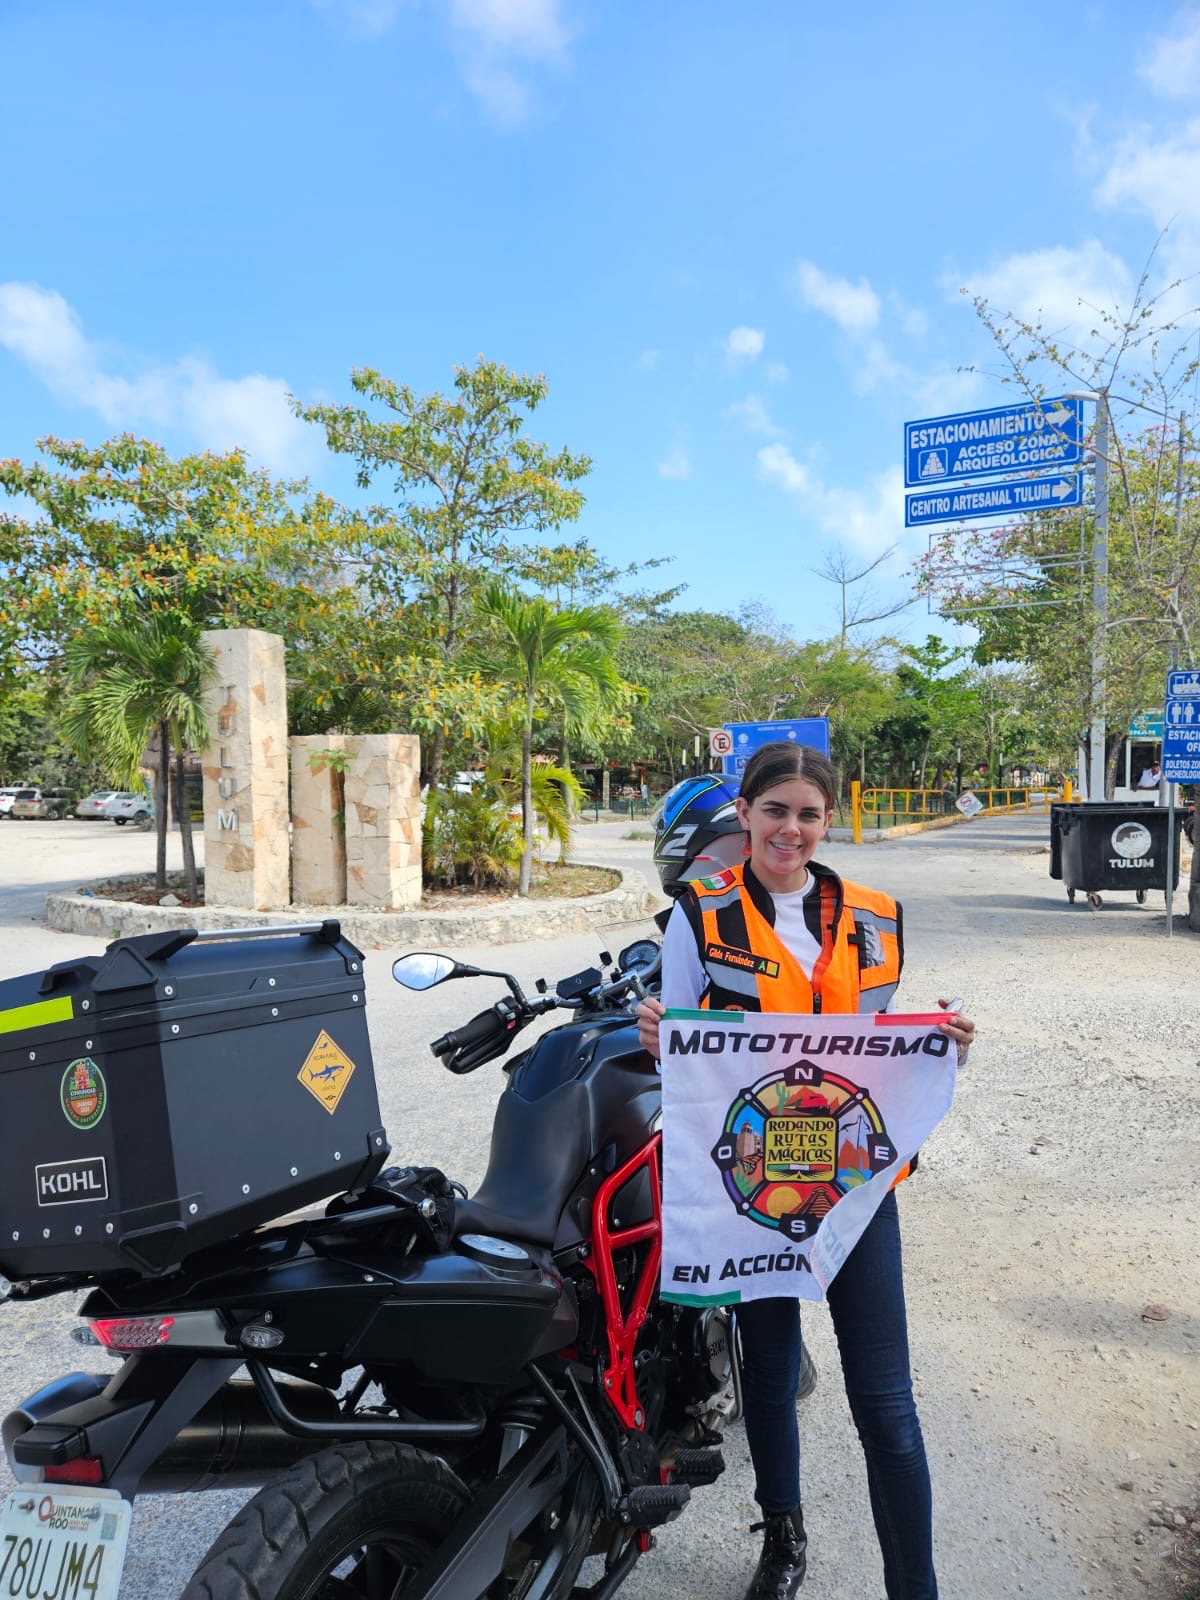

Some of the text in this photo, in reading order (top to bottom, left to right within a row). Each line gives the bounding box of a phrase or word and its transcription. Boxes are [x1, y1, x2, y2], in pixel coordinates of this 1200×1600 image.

[910, 412, 1044, 449] ESTACIONAMIENTO
[958, 432, 1059, 459] ACCESO ZONA
[953, 446, 1066, 473] ARQUEOLOGICA
[911, 484, 1051, 517] CENTRO ARTESANAL TULUM
[1168, 730, 1200, 741] ESTACI
[217, 684, 238, 831] TULUM
[1165, 759, 1190, 769] BOLETOS
[1108, 858, 1154, 869] TULUM
[709, 947, 723, 960] Gilda
[668, 1029, 950, 1058] MOTOTURISMO
[794, 1067, 814, 1081] N
[719, 1148, 732, 1160] O
[874, 1146, 890, 1161] E
[40, 1169, 102, 1196] KOHL
[790, 1220, 806, 1234] S
[671, 1264, 710, 1284] EN
[718, 1246, 813, 1281] ACCIÓN
[49, 1517, 69, 1530] ROO
